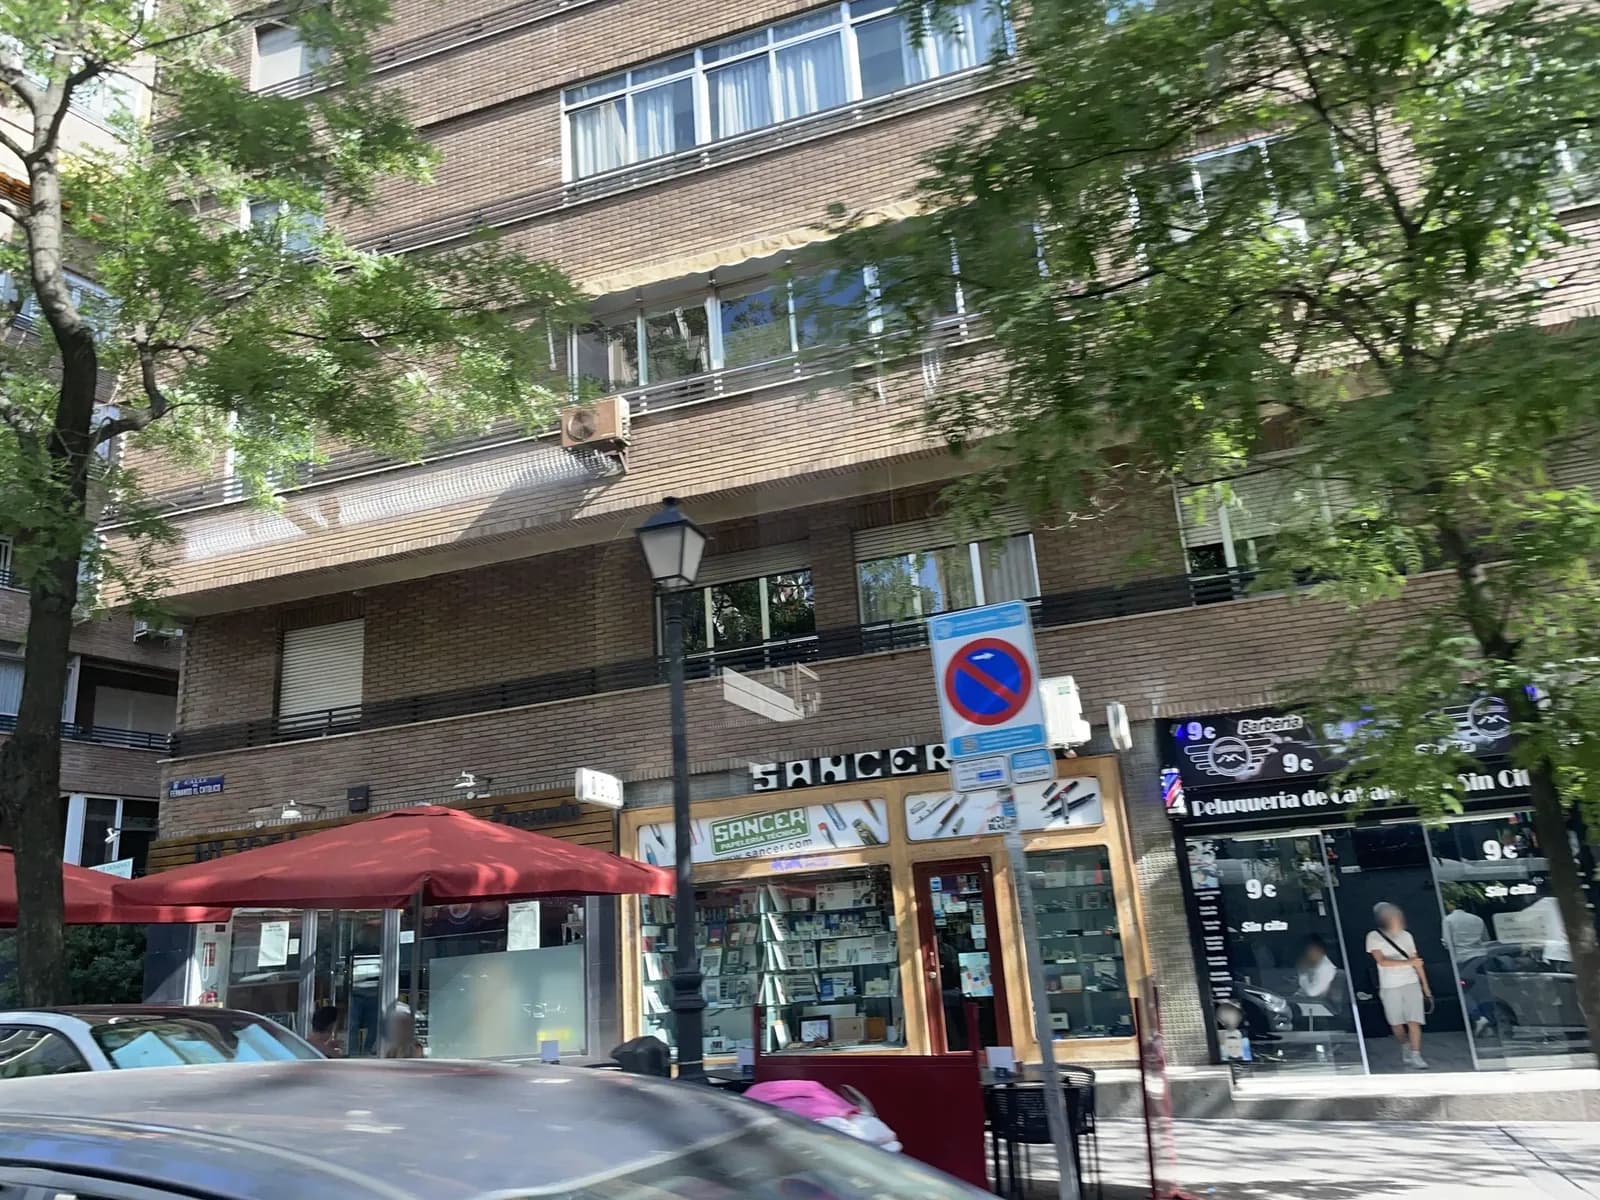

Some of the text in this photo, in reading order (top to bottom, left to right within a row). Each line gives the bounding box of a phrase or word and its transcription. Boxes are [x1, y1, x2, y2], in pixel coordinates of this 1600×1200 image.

[752, 744, 949, 791] SANCER
[1302, 789, 1329, 807] de
[714, 808, 805, 842] SANCER
[1245, 879, 1278, 900] 9€
